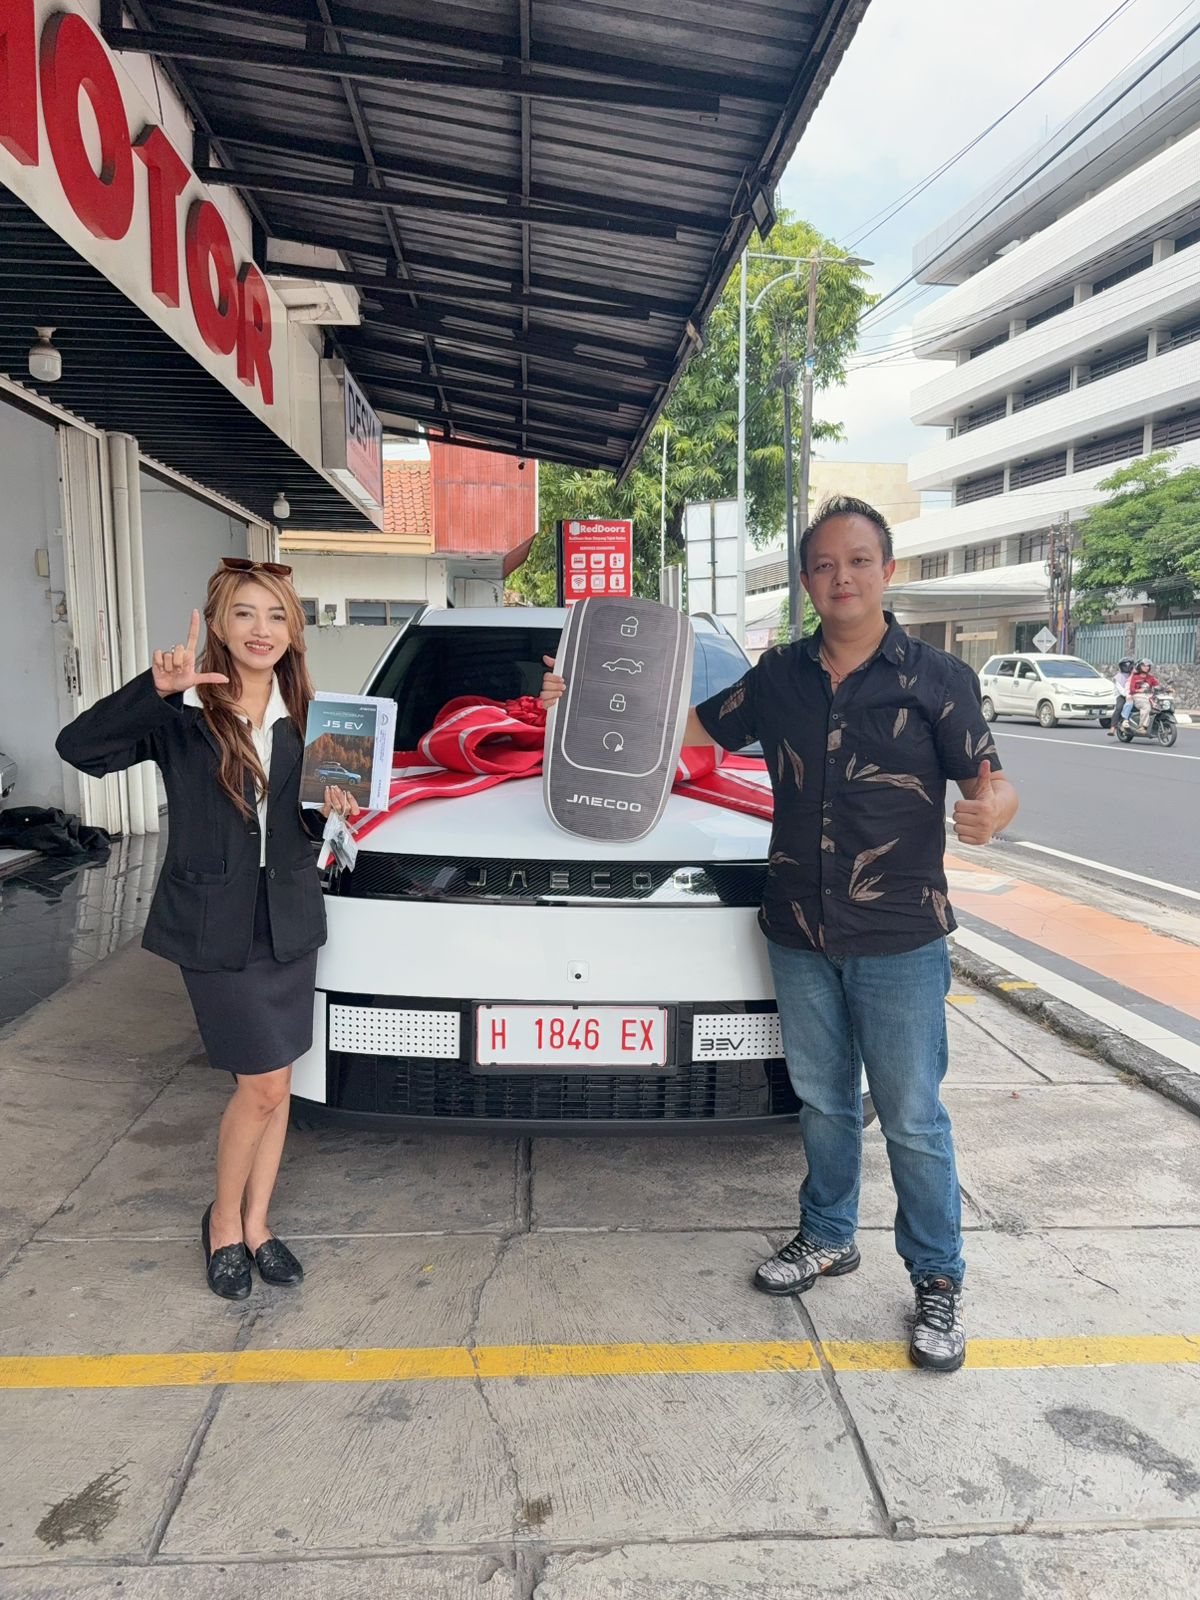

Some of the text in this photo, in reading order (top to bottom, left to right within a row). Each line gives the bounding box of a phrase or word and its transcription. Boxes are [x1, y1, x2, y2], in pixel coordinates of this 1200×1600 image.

[580, 523, 626, 533] RedDoorz
[344, 721, 364, 730] EV
[566, 794, 642, 813] JAECOO
[466, 867, 693, 889] JAECOO
[490, 1018, 654, 1051] H 1846 EX
[700, 1037, 745, 1051] BEV
